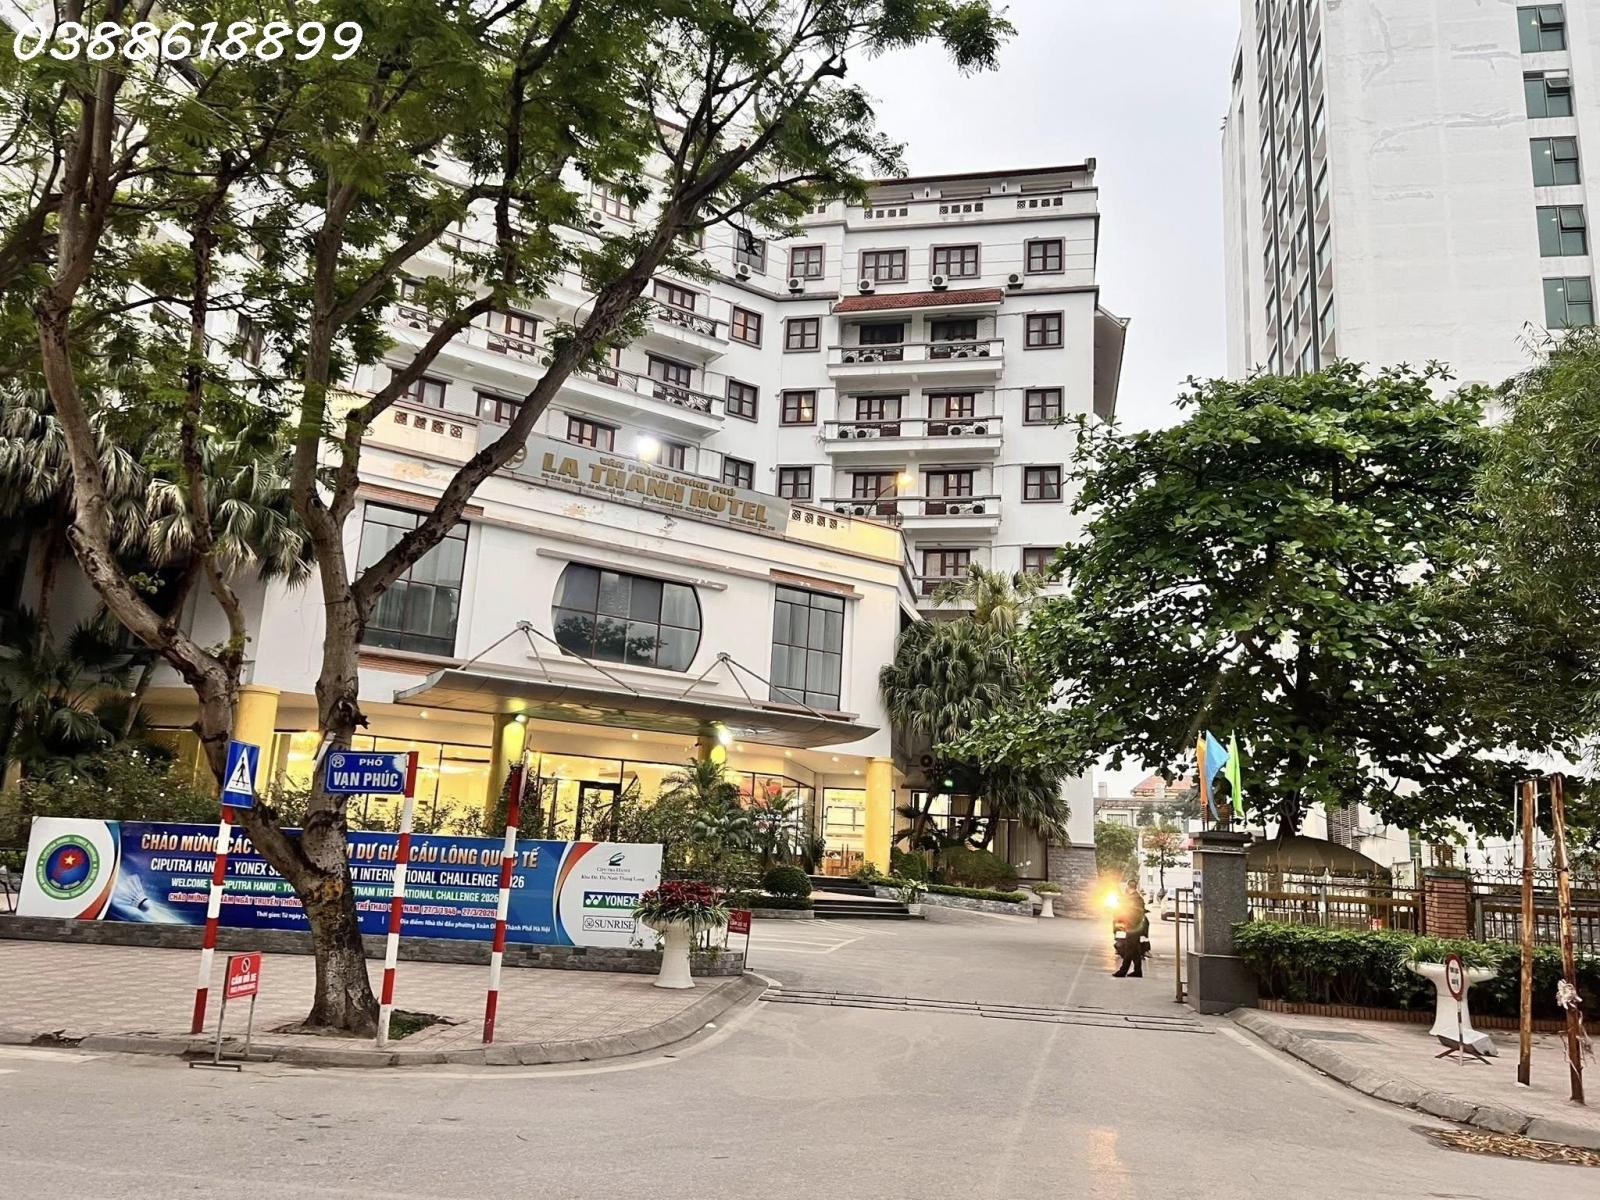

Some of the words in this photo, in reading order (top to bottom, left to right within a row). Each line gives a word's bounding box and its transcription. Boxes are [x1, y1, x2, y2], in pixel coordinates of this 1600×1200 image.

[542, 452, 579, 479] LA
[588, 463, 685, 503] THANH
[689, 488, 768, 523] HOTEL
[359, 755, 384, 766] PHỐ
[333, 772, 360, 789] VẠN
[363, 769, 399, 787] PHÚC
[141, 831, 177, 851] CHÀO
[356, 842, 378, 863] DỰ
[409, 841, 438, 862] CẦU
[440, 844, 478, 865] LÔNG
[522, 846, 541, 868] TẾ
[151, 858, 192, 872] CIPUTRA
[194, 859, 216, 873] HAN
[234, 861, 268, 875] YONEX
[360, 867, 437, 884] INTERNTIONAL
[440, 871, 498, 887] CHALLENGE
[171, 878, 208, 888] WELCOME
[253, 881, 277, 892] HANOI
[436, 891, 480, 902] CHALLENGE
[481, 893, 499, 903] 2026
[403, 904, 420, 914] NAM
[605, 895, 636, 907] YONEX
[594, 919, 634, 930] SUNRISE
